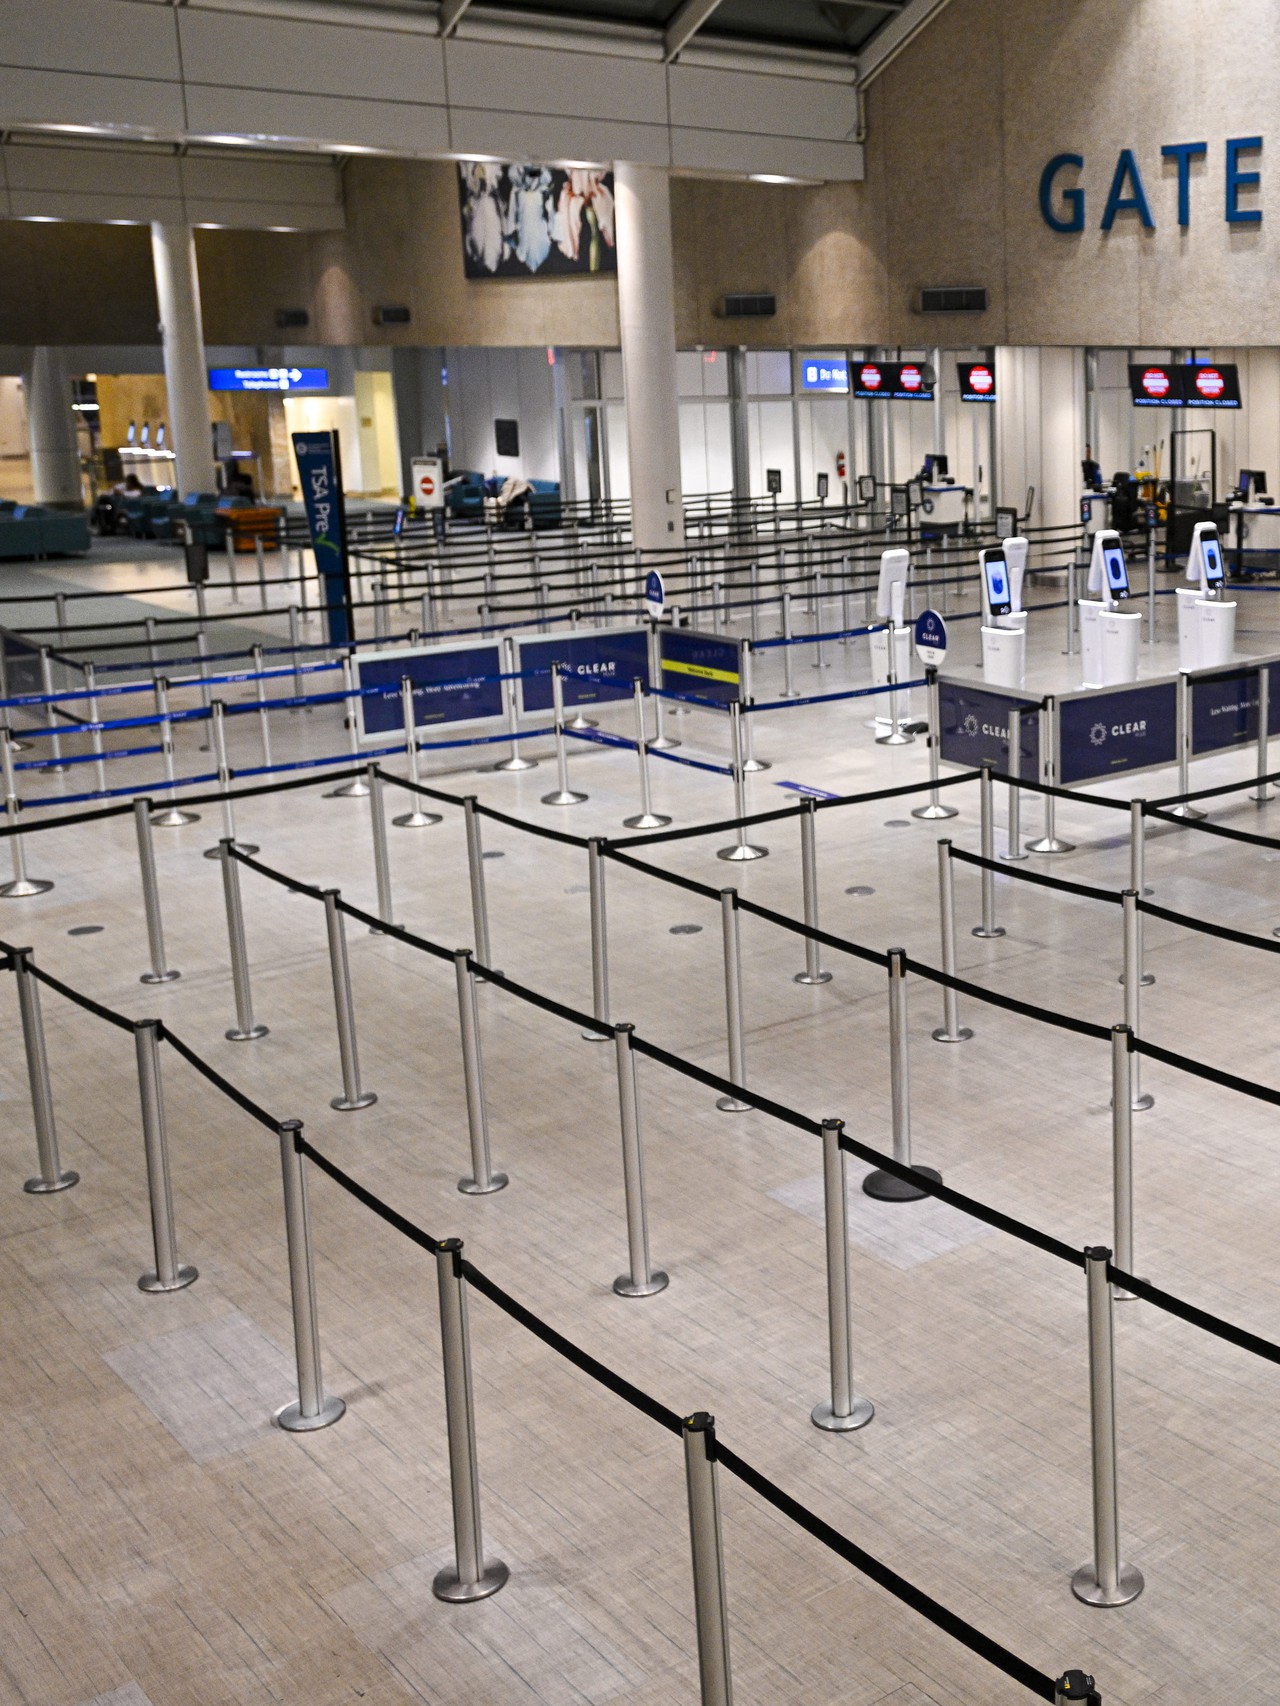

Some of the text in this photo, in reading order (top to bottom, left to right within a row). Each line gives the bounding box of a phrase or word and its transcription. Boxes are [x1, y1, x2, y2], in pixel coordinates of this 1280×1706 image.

[311, 465, 329, 501] TSA
[314, 502, 330, 532] Pre
[922, 632, 939, 642] CLEAR
[577, 661, 616, 676] CLEAR
[1111, 720, 1147, 736] CLEAR
